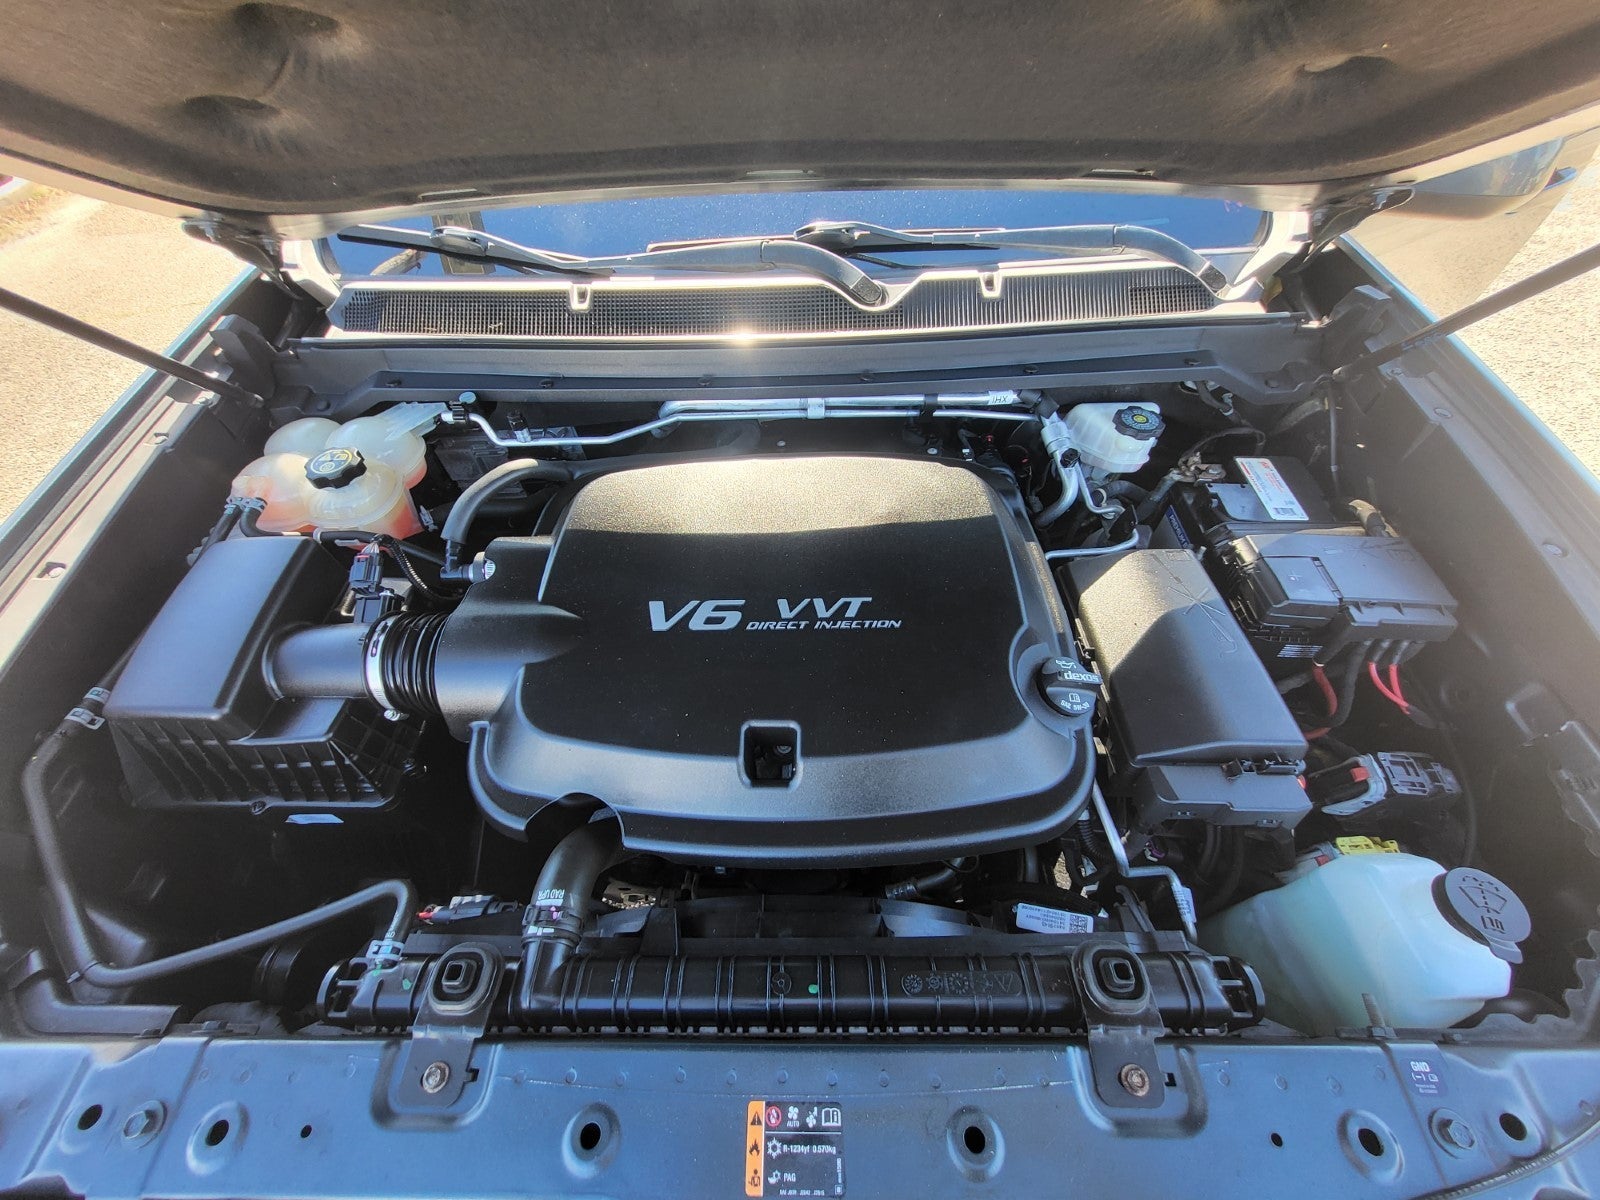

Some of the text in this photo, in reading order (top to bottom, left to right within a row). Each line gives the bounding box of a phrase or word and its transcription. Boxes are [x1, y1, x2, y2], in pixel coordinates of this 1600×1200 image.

[649, 597, 873, 631] V6 VVT
[745, 619, 902, 630] DIRECT INJECTION
[1064, 671, 1099, 682] dexos
[1410, 1061, 1430, 1072] GND
[783, 1144, 837, 1155] R-1234yf 0.570kg
[783, 1172, 796, 1182] PAG
